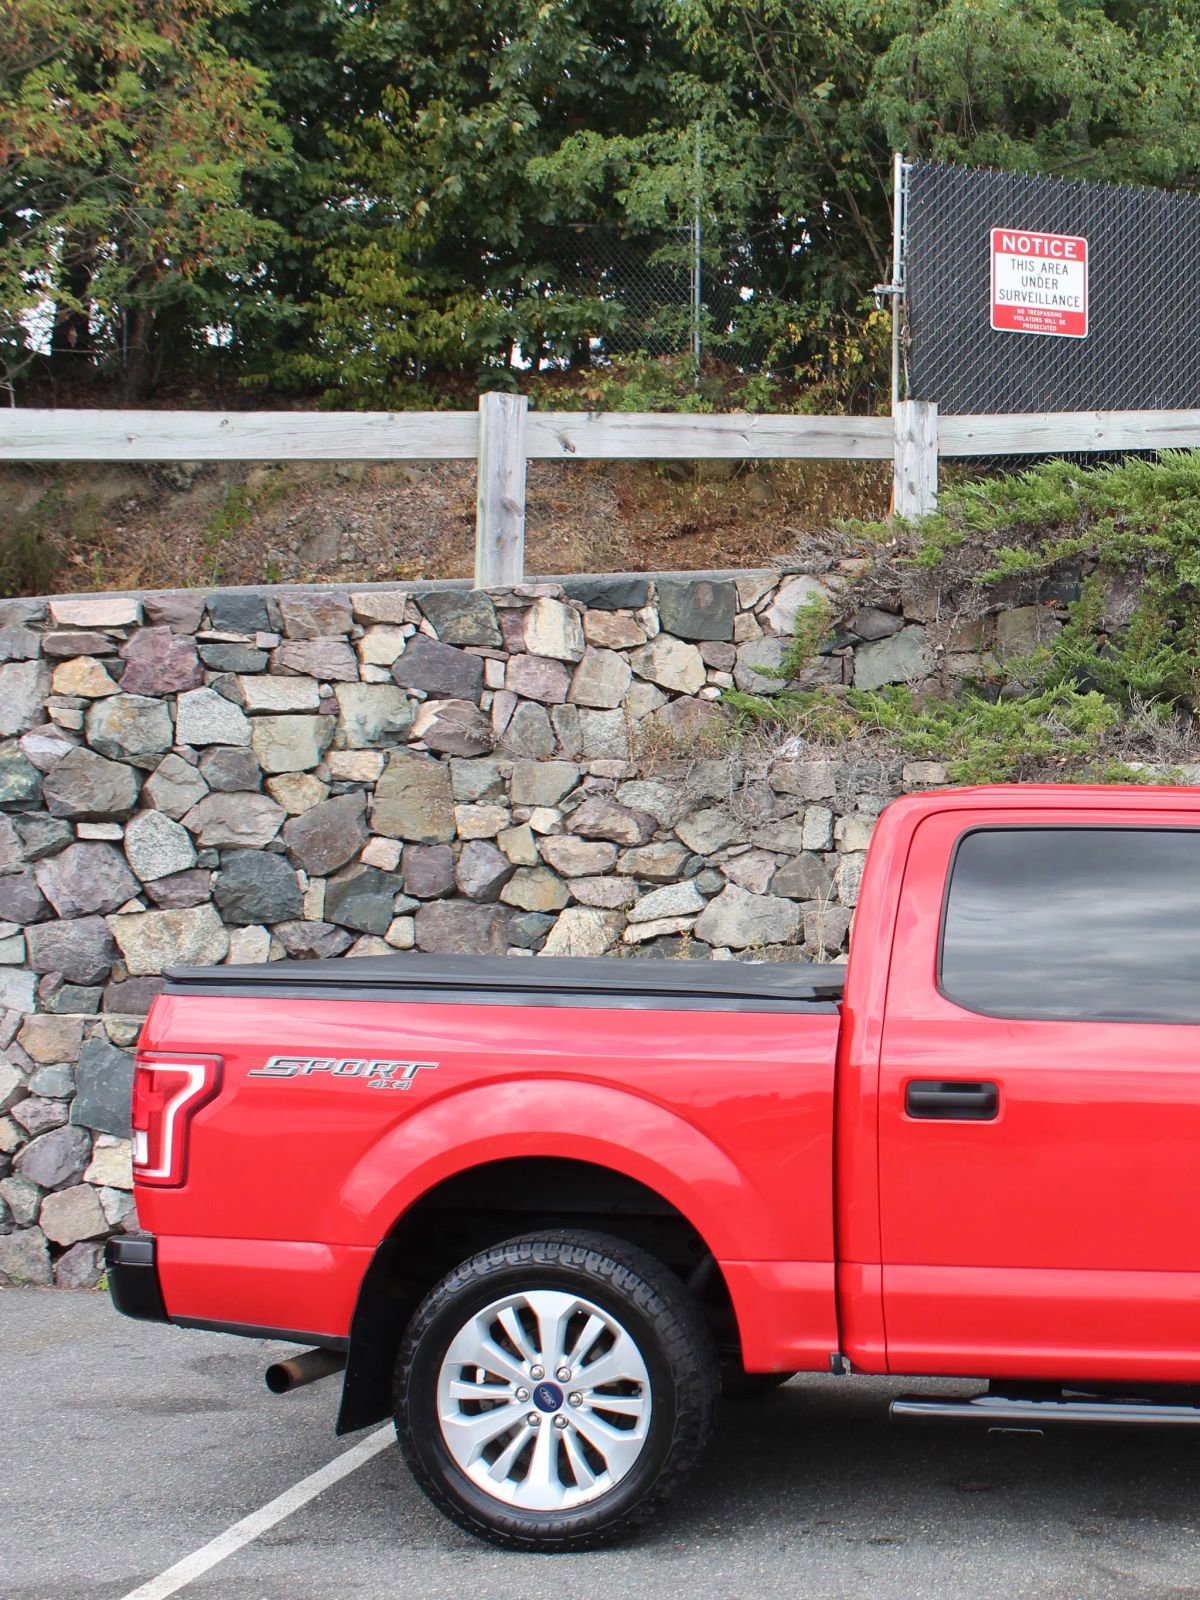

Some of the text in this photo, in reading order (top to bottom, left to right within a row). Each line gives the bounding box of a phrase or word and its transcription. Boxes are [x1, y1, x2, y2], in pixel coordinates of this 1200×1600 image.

[1002, 234, 1077, 258] NOTICE
[1011, 258, 1069, 276] THIS AREA
[1021, 275, 1059, 290] UNDER
[999, 288, 1081, 308] SURVEILLANCE
[1013, 316, 1042, 324] VIOLATORS
[1027, 309, 1062, 318] TRESPASSING
[1023, 323, 1057, 332] PROSECUTED
[247, 1055, 440, 1080] SPORT
